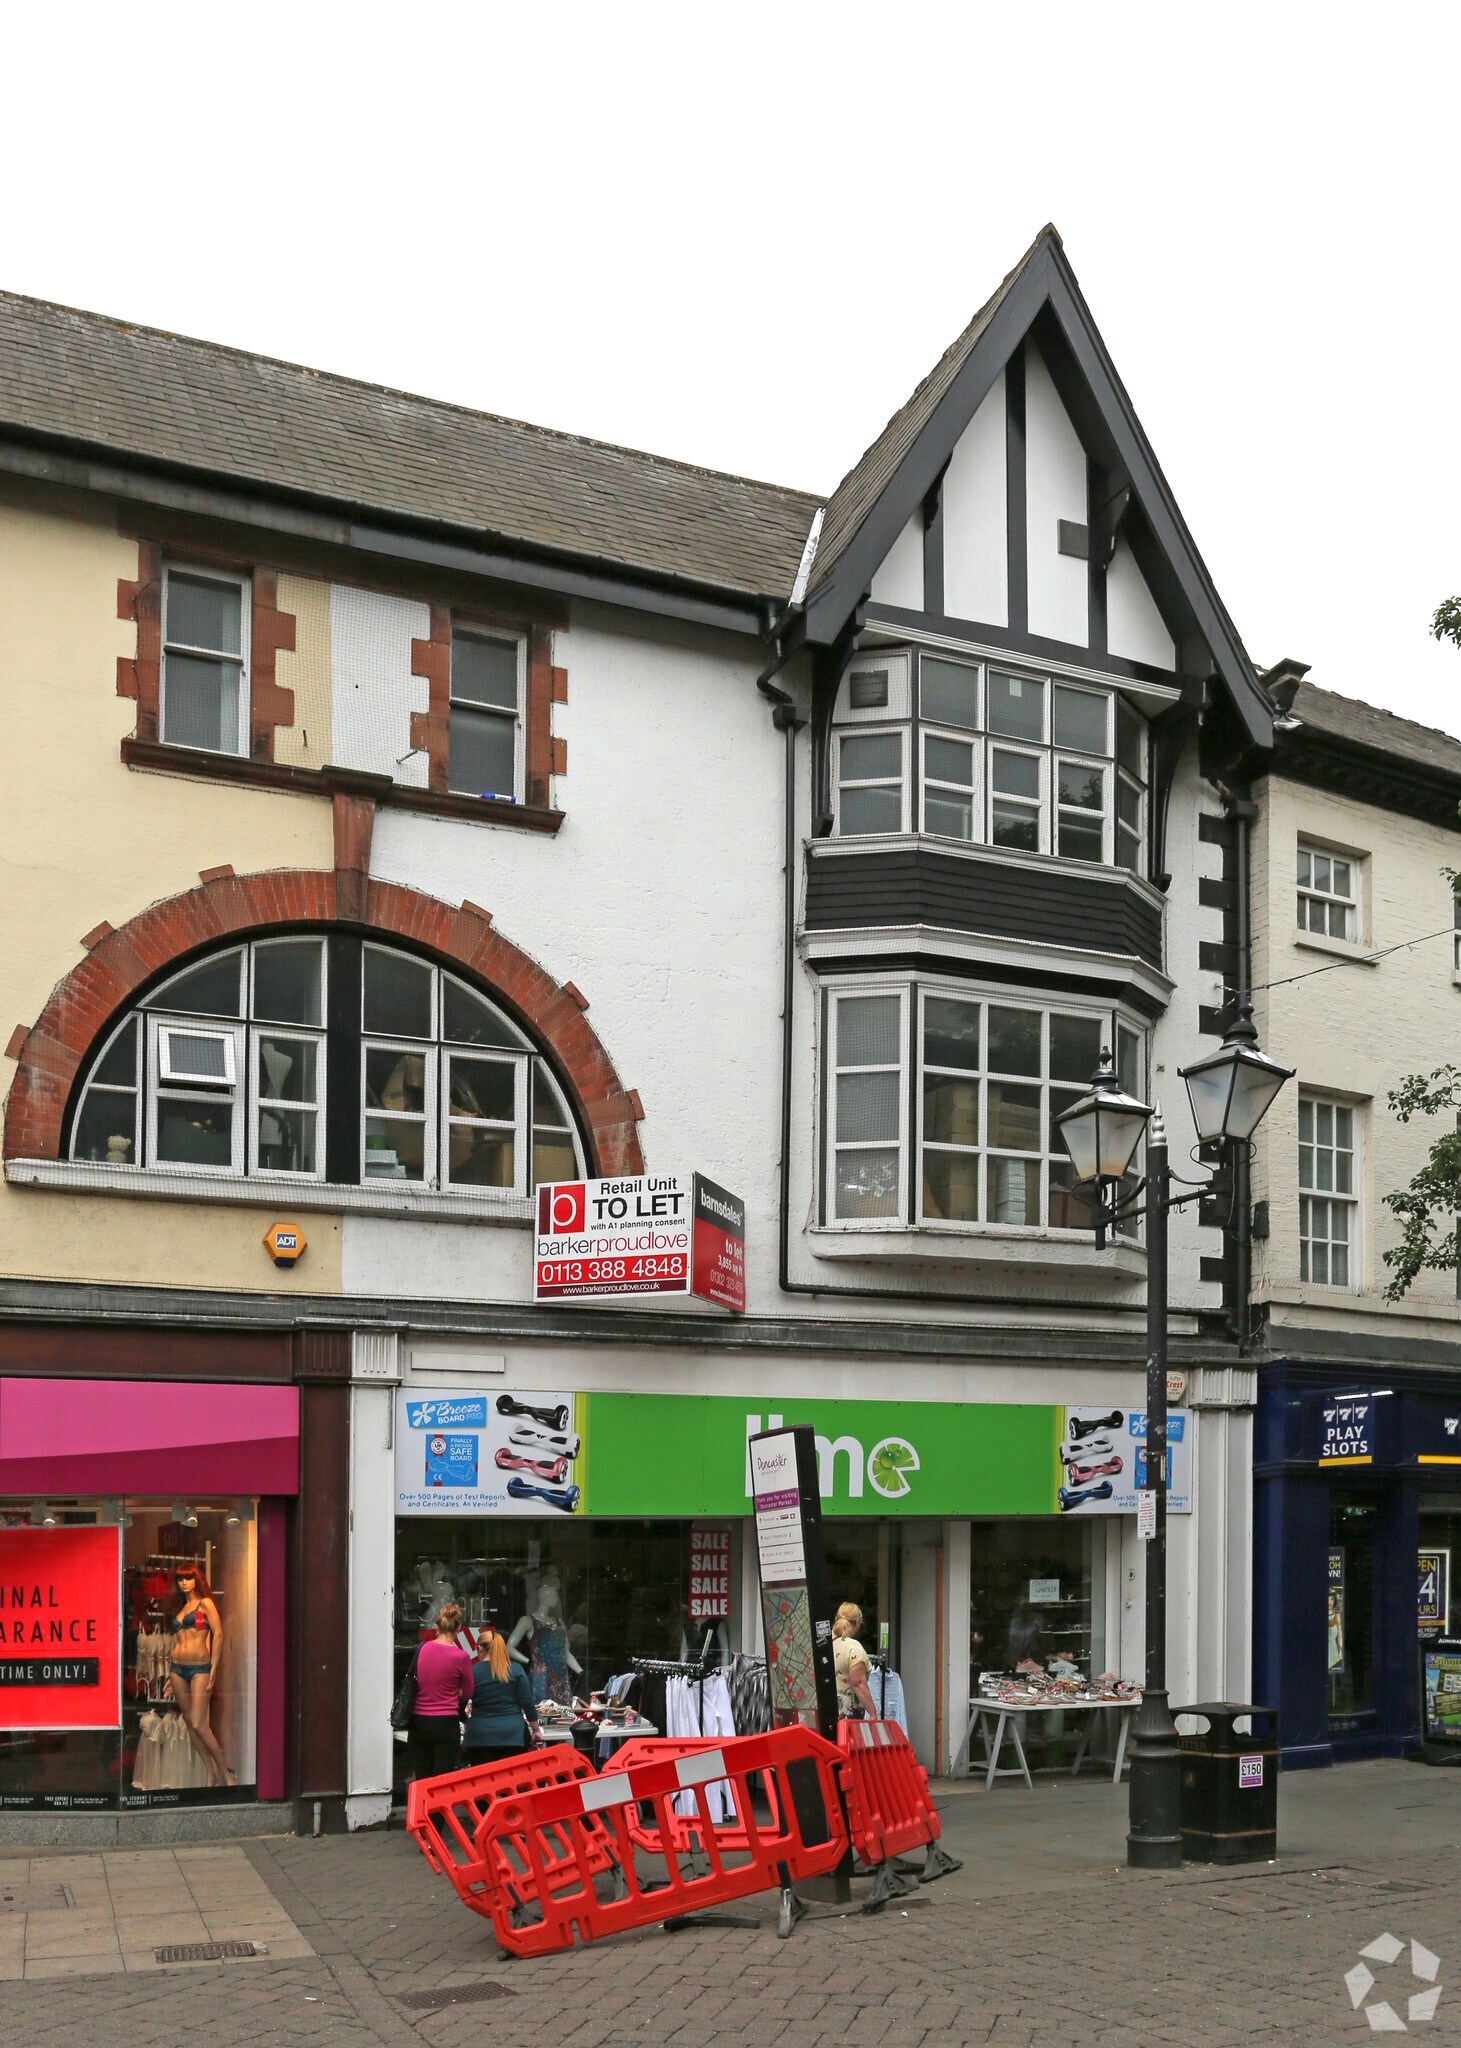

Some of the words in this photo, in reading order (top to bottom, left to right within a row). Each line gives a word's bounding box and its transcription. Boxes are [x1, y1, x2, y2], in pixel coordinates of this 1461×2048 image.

[600, 1179, 642, 1195] Retail
[648, 1177, 678, 1192] Unit
[592, 1197, 628, 1220] TO
[636, 1193, 685, 1217] LET
[700, 1187, 741, 1227] barnsdales
[590, 1222, 607, 1231] with
[608, 1222, 618, 1230] A1
[620, 1219, 653, 1231] planning
[655, 1217, 686, 1227] consent
[277, 1236, 297, 1247] ADT
[537, 1231, 689, 1257] barkerproudlove
[725, 1238, 733, 1256] to
[733, 1241, 743, 1262] let
[541, 1262, 583, 1283] 0113
[588, 1260, 626, 1280] 388
[631, 1256, 683, 1277] 4848
[562, 1281, 660, 1296] www.barkerproudlove.co.uk
[436, 1402, 482, 1416] Breeze
[438, 1414, 465, 1424] BOARD
[1327, 1425, 1364, 1441] PLAY
[1322, 1440, 1368, 1456] SLOTS
[757, 1453, 787, 1470] Doncaster
[433, 1493, 454, 1501] Pages
[480, 1493, 506, 1501] Reports
[691, 1532, 728, 1550] SALE
[691, 1554, 728, 1571] SALE
[691, 1577, 728, 1594] SALE
[0, 1585, 59, 1608] INAL
[691, 1598, 728, 1616] SALE
[0, 1666, 33, 1679] TIME
[43, 1665, 87, 1679] ONLY!
[1176, 1739, 1207, 1750] LITTER
[1242, 1763, 1262, 1776] £150
